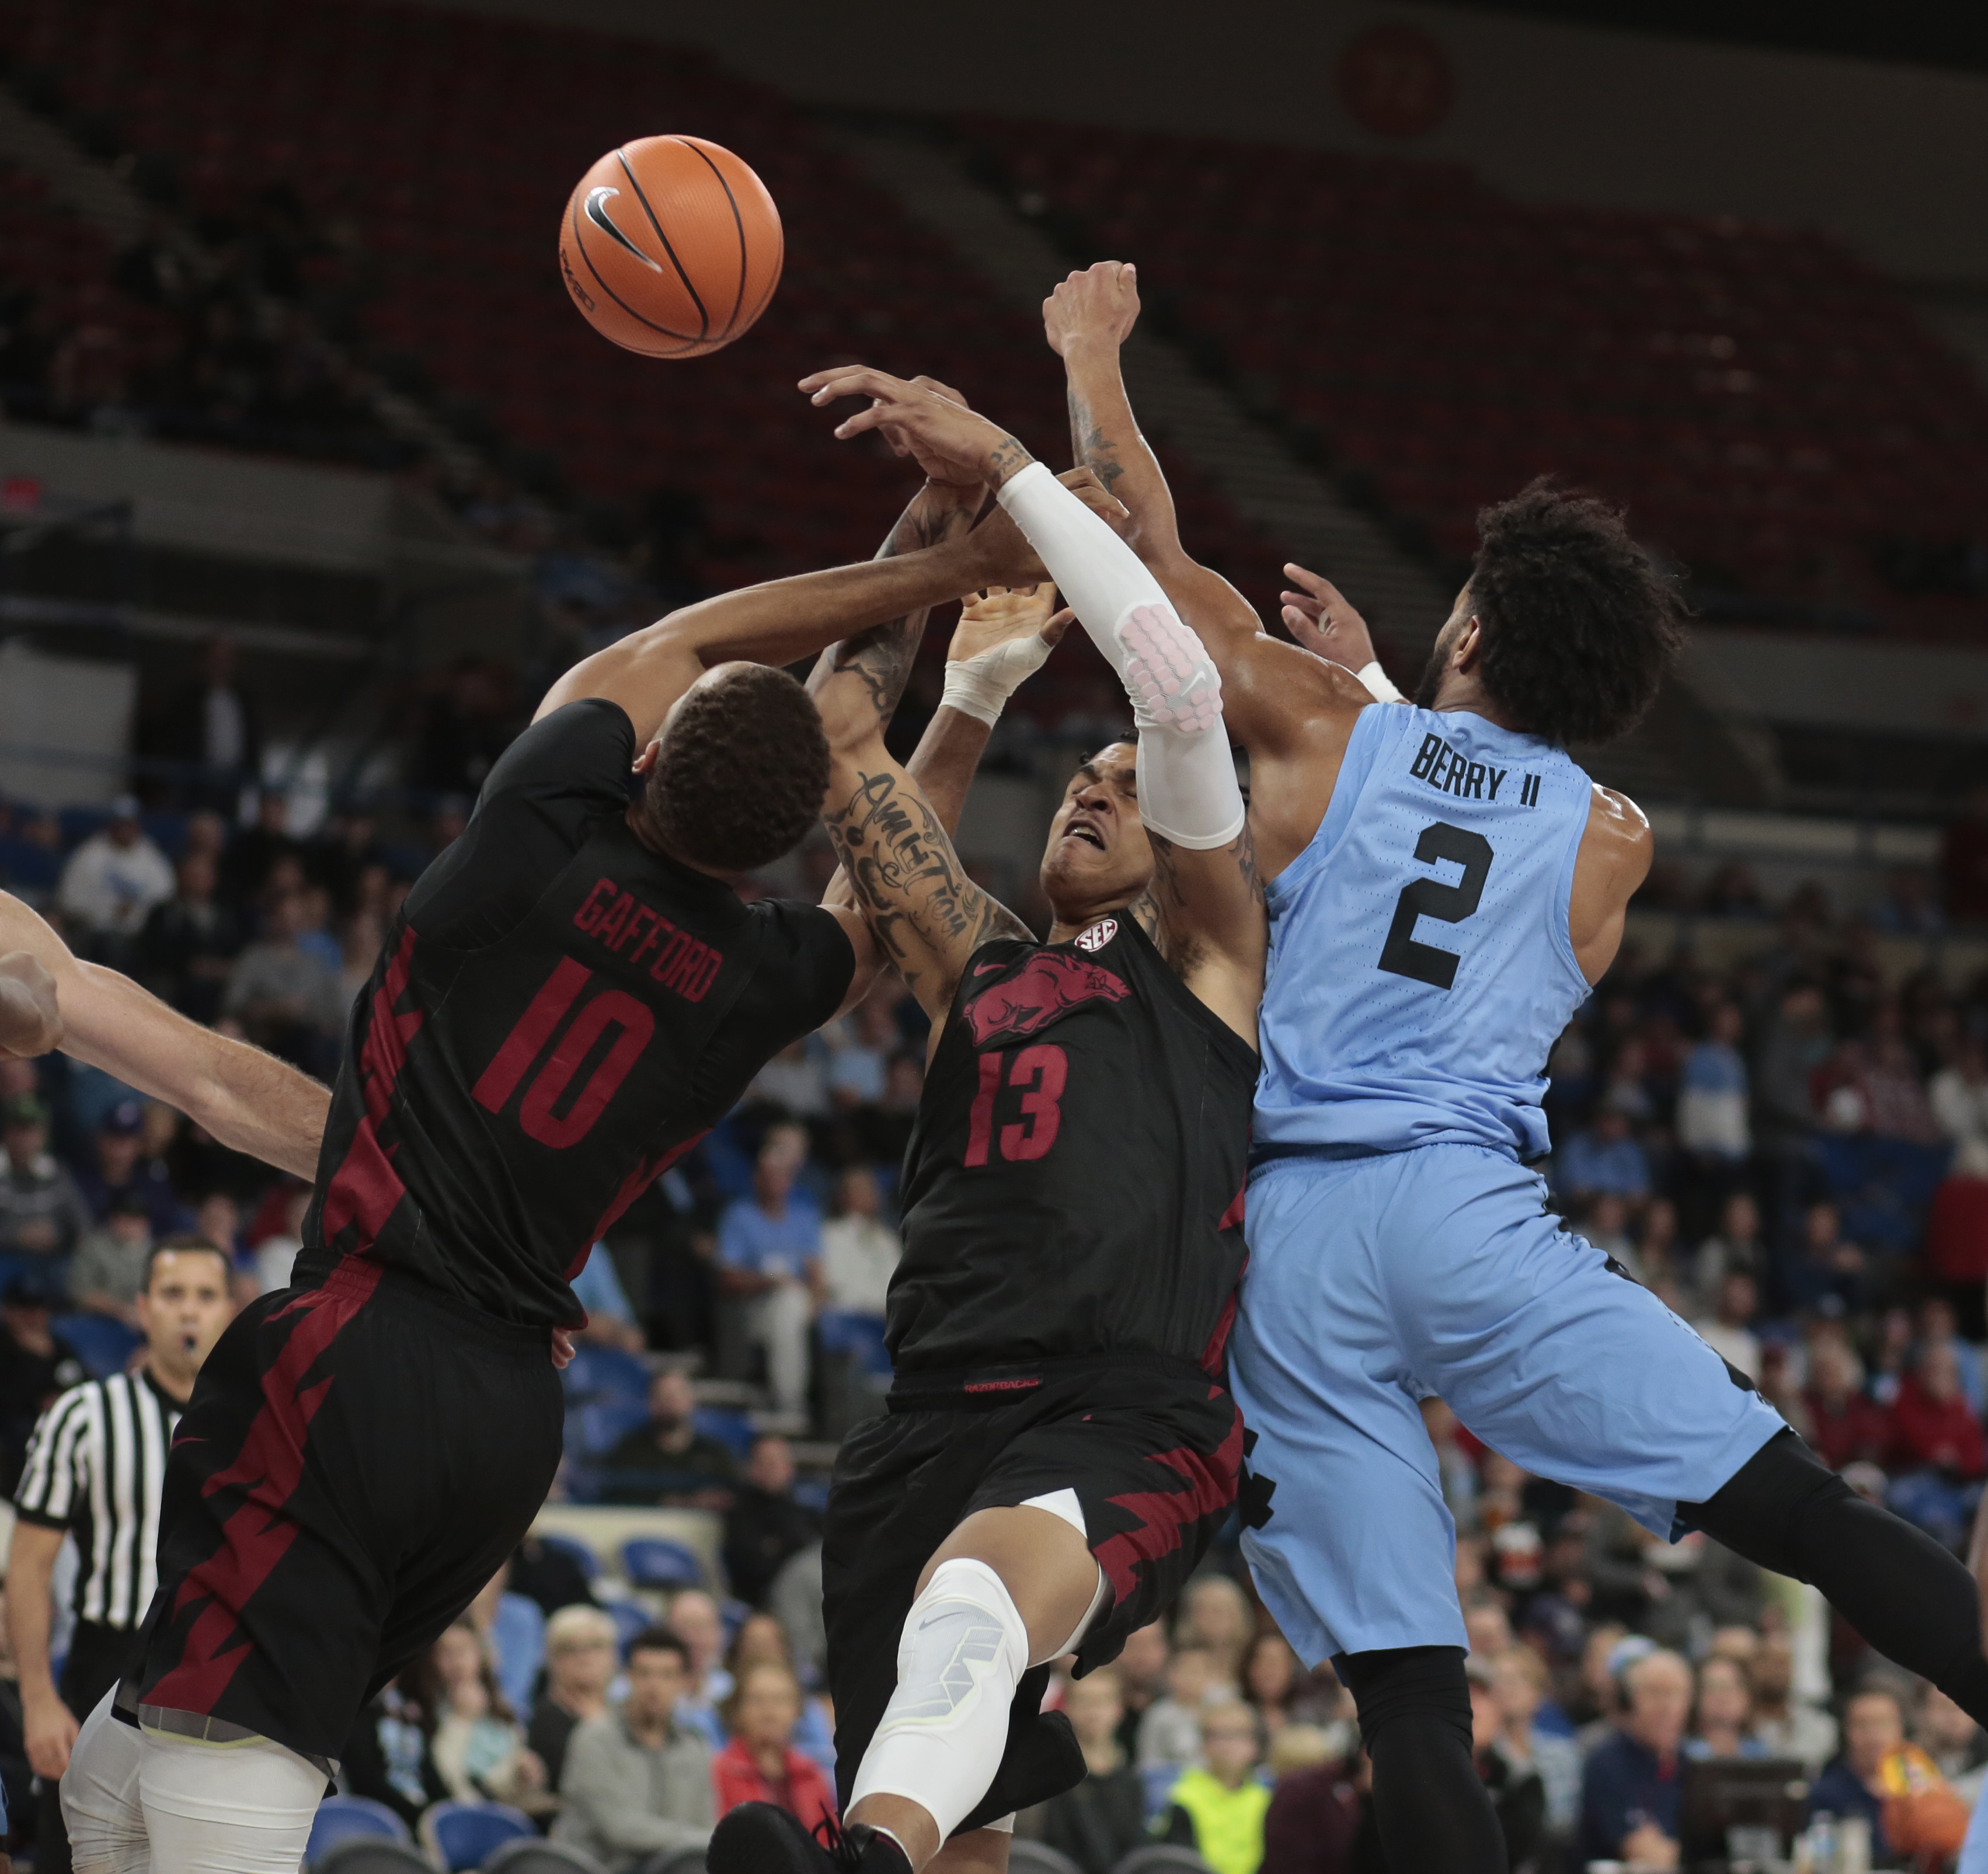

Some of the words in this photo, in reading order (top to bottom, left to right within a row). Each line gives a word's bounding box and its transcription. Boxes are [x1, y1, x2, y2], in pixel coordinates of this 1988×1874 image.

[1409, 733, 1507, 800] BERRY
[1520, 774, 1541, 807] II
[573, 878, 723, 1003] GAFFORD
[1078, 921, 1115, 950] SEC
[1377, 821, 1494, 990] 2
[471, 955, 655, 1149] 10
[963, 1044, 1068, 1167] 13
[965, 1378, 1039, 1394] RAZORBACKS
